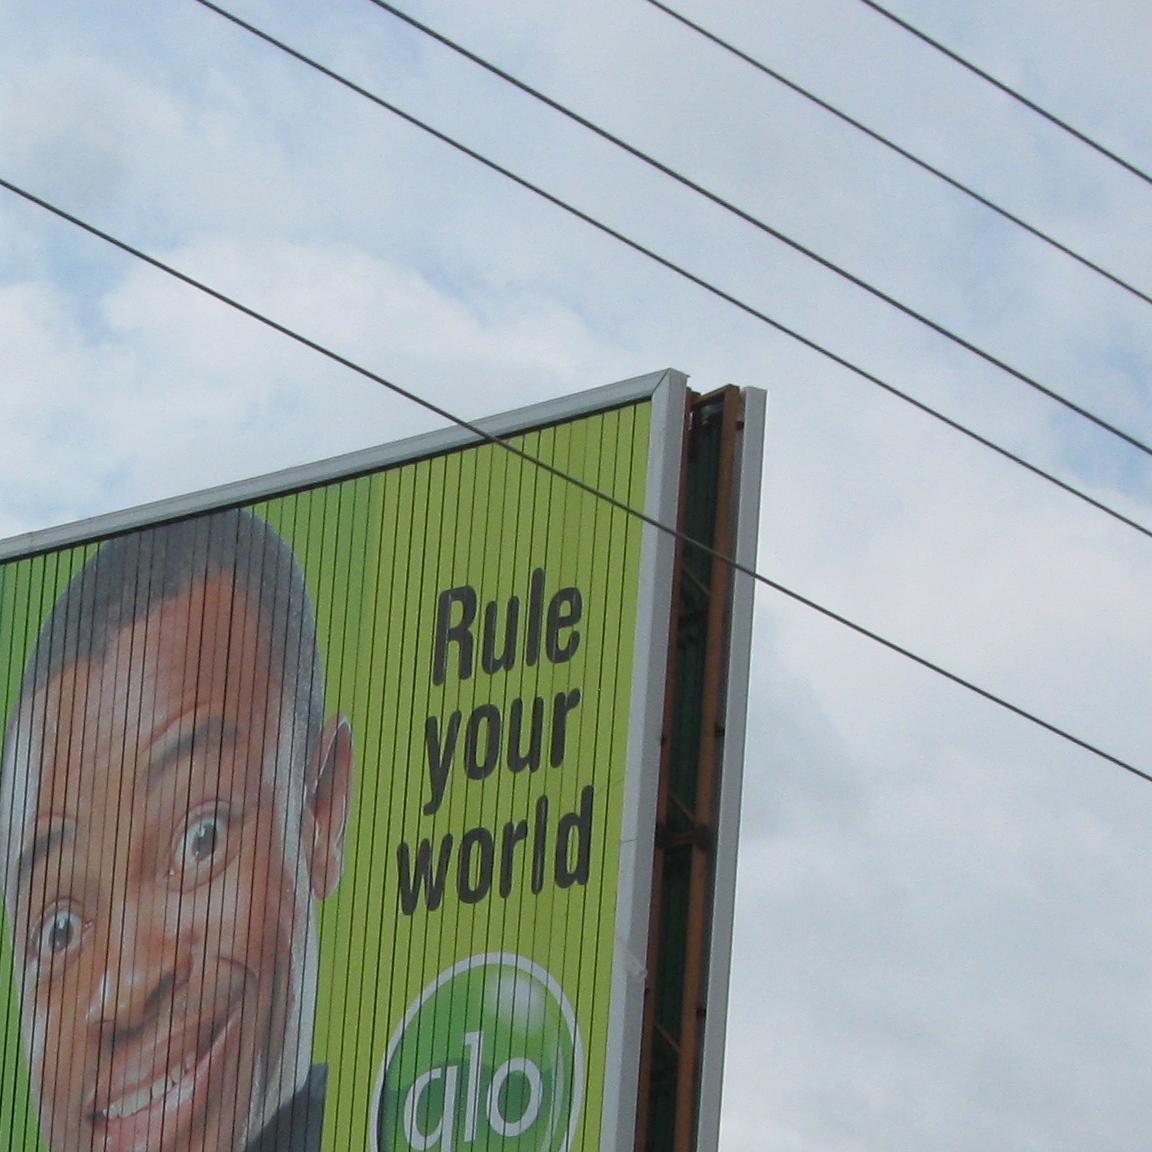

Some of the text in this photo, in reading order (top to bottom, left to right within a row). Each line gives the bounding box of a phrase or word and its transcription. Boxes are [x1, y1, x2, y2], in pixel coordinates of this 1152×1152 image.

[432, 567, 583, 688] Rule
[424, 684, 582, 816] your
[396, 785, 594, 917] world
